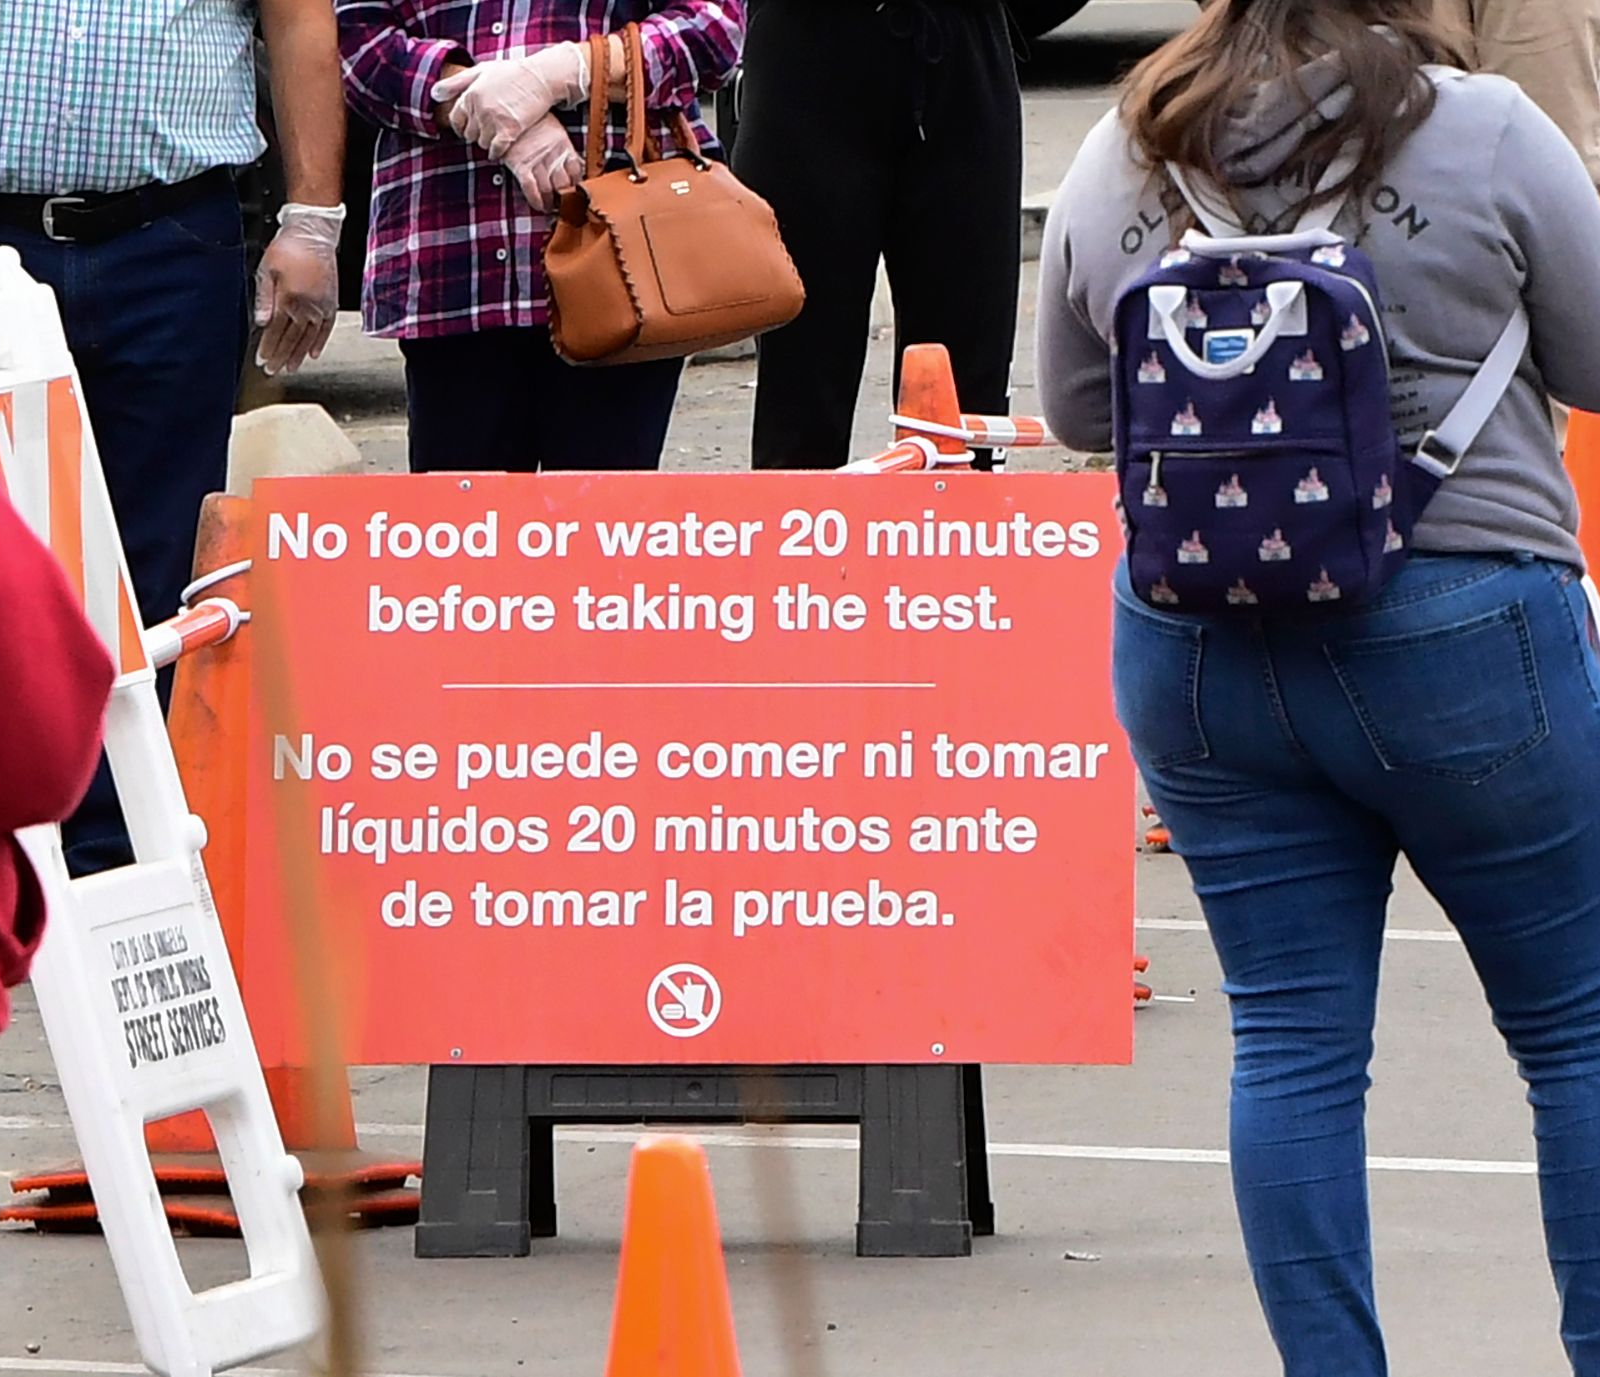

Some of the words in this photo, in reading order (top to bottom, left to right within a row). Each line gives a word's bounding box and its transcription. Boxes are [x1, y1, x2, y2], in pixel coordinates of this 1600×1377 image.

[269, 512, 348, 559] No
[365, 510, 498, 559] food
[517, 521, 580, 558] or
[595, 512, 763, 557] water
[778, 509, 848, 557] 20
[866, 509, 1100, 558] minutes
[368, 584, 556, 632] before
[572, 583, 754, 642] taking
[772, 583, 867, 631] the
[883, 585, 1012, 631] test.
[272, 733, 352, 781] No
[371, 743, 438, 780] se
[457, 731, 638, 790] puede
[657, 742, 846, 778] comer
[864, 730, 913, 778] ni
[931, 733, 1109, 779] tomar
[321, 802, 549, 864] líquidos
[566, 805, 636, 853] 20
[654, 804, 891, 852] minutos
[909, 807, 1038, 853] ante
[381, 879, 453, 927] de
[470, 882, 647, 927] tomar
[665, 879, 713, 927] la
[733, 879, 954, 937] prueba.
[123, 1012, 168, 1069] STREET
[166, 996, 226, 1057] SERVICES
